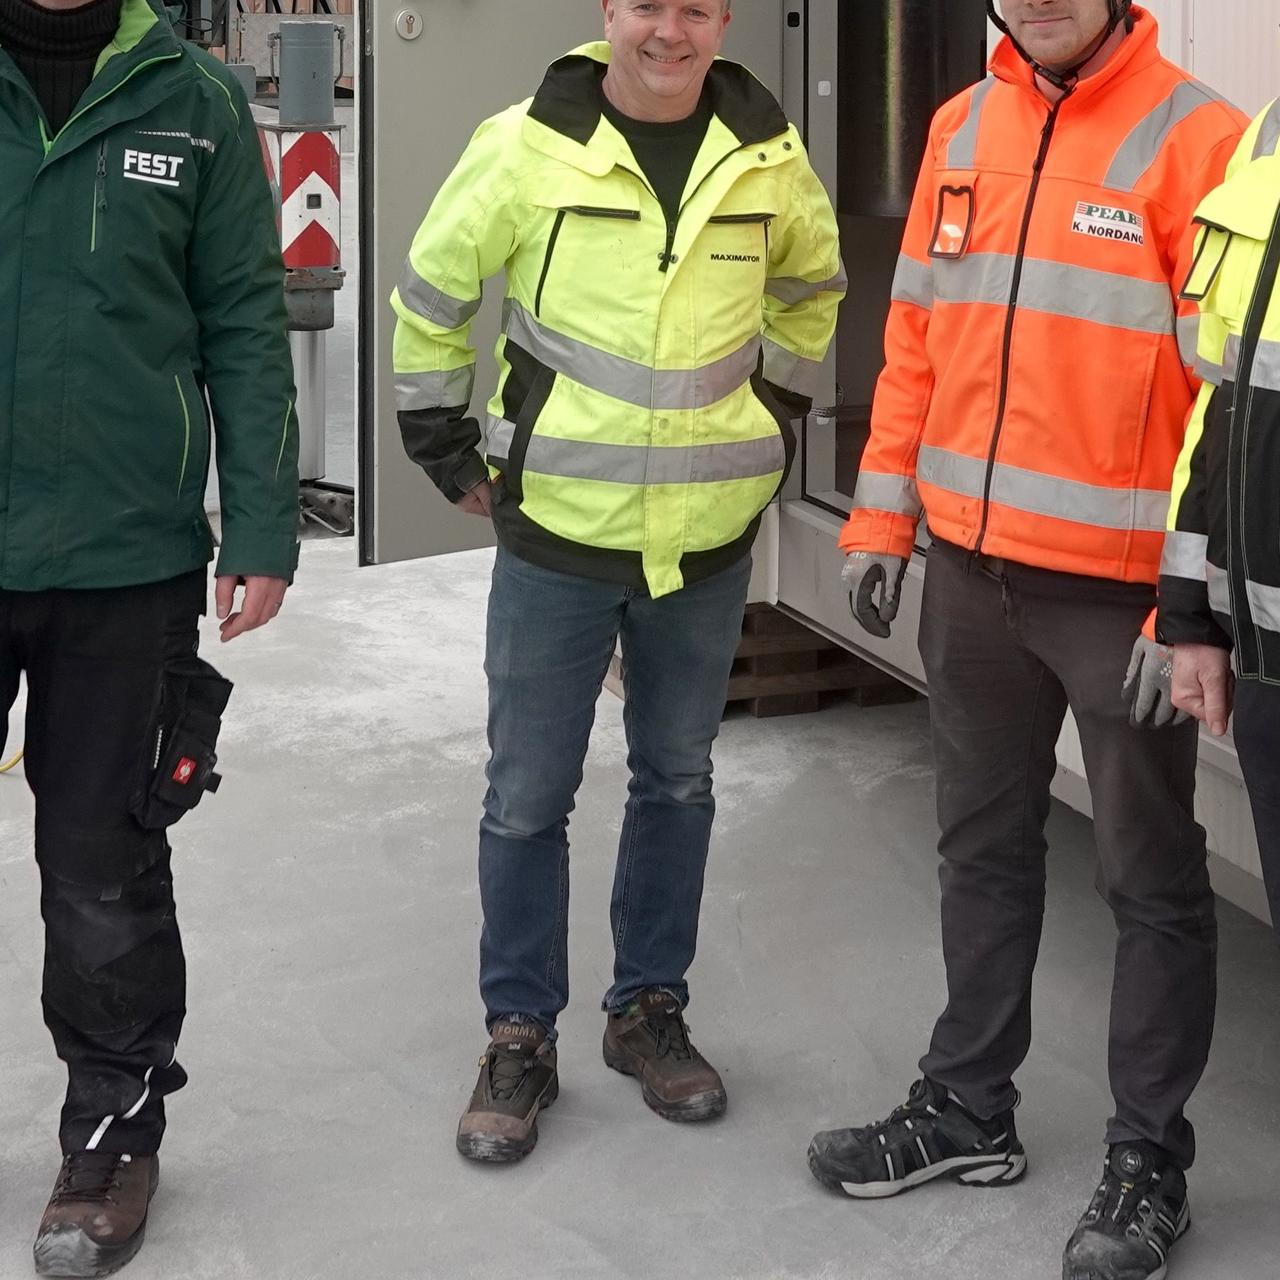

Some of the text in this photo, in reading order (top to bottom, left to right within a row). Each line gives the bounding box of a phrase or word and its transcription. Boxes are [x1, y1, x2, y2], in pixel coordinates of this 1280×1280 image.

[123, 149, 184, 178] FEST
[1085, 204, 1137, 225] PEAB
[1072, 221, 1084, 232] K.
[710, 253, 761, 262] MAXIMATOR
[497, 1025, 537, 1040] FORMA
